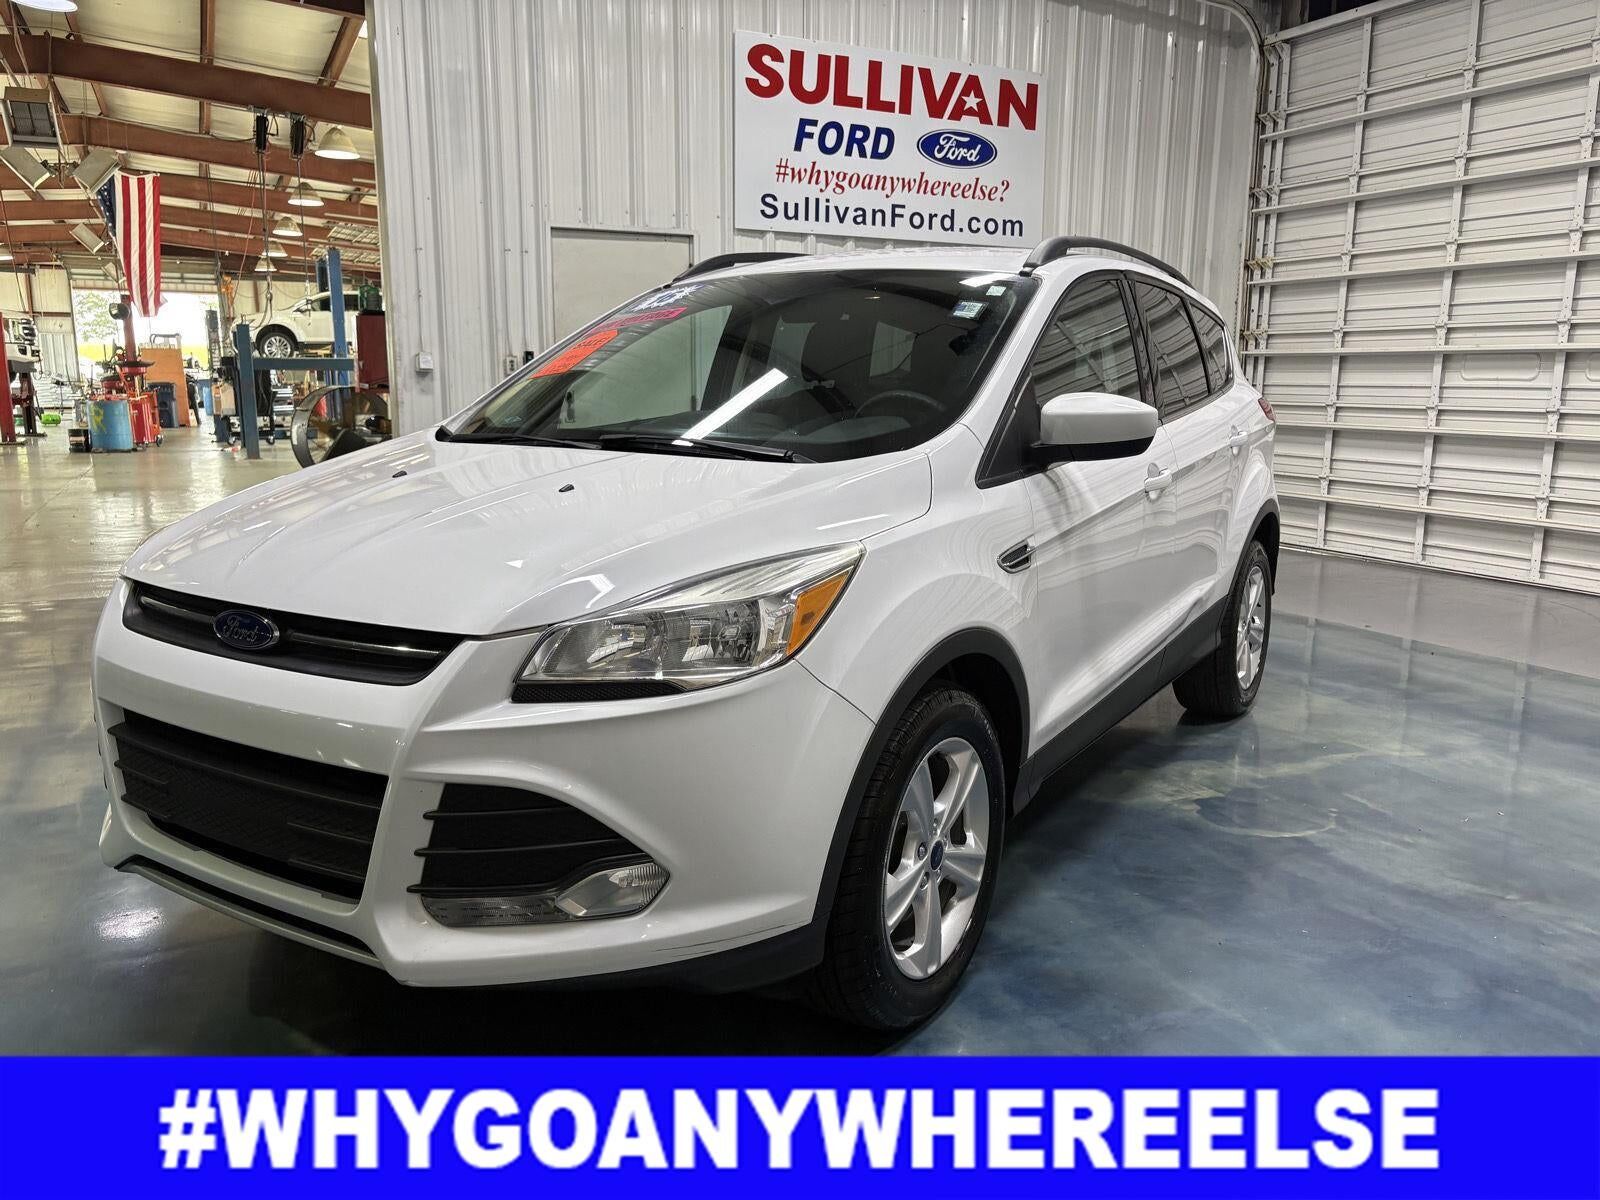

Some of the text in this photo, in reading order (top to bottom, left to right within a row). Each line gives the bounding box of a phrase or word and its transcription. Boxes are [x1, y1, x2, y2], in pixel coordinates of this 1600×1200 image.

[745, 43, 1039, 131] SULLIVAN
[793, 118, 895, 160] FORD
[933, 133, 980, 163] Ford
[775, 157, 1010, 203] #whygoanywhereelse?
[759, 193, 1024, 237] SullivanFord.com
[223, 615, 259, 643] Ford
